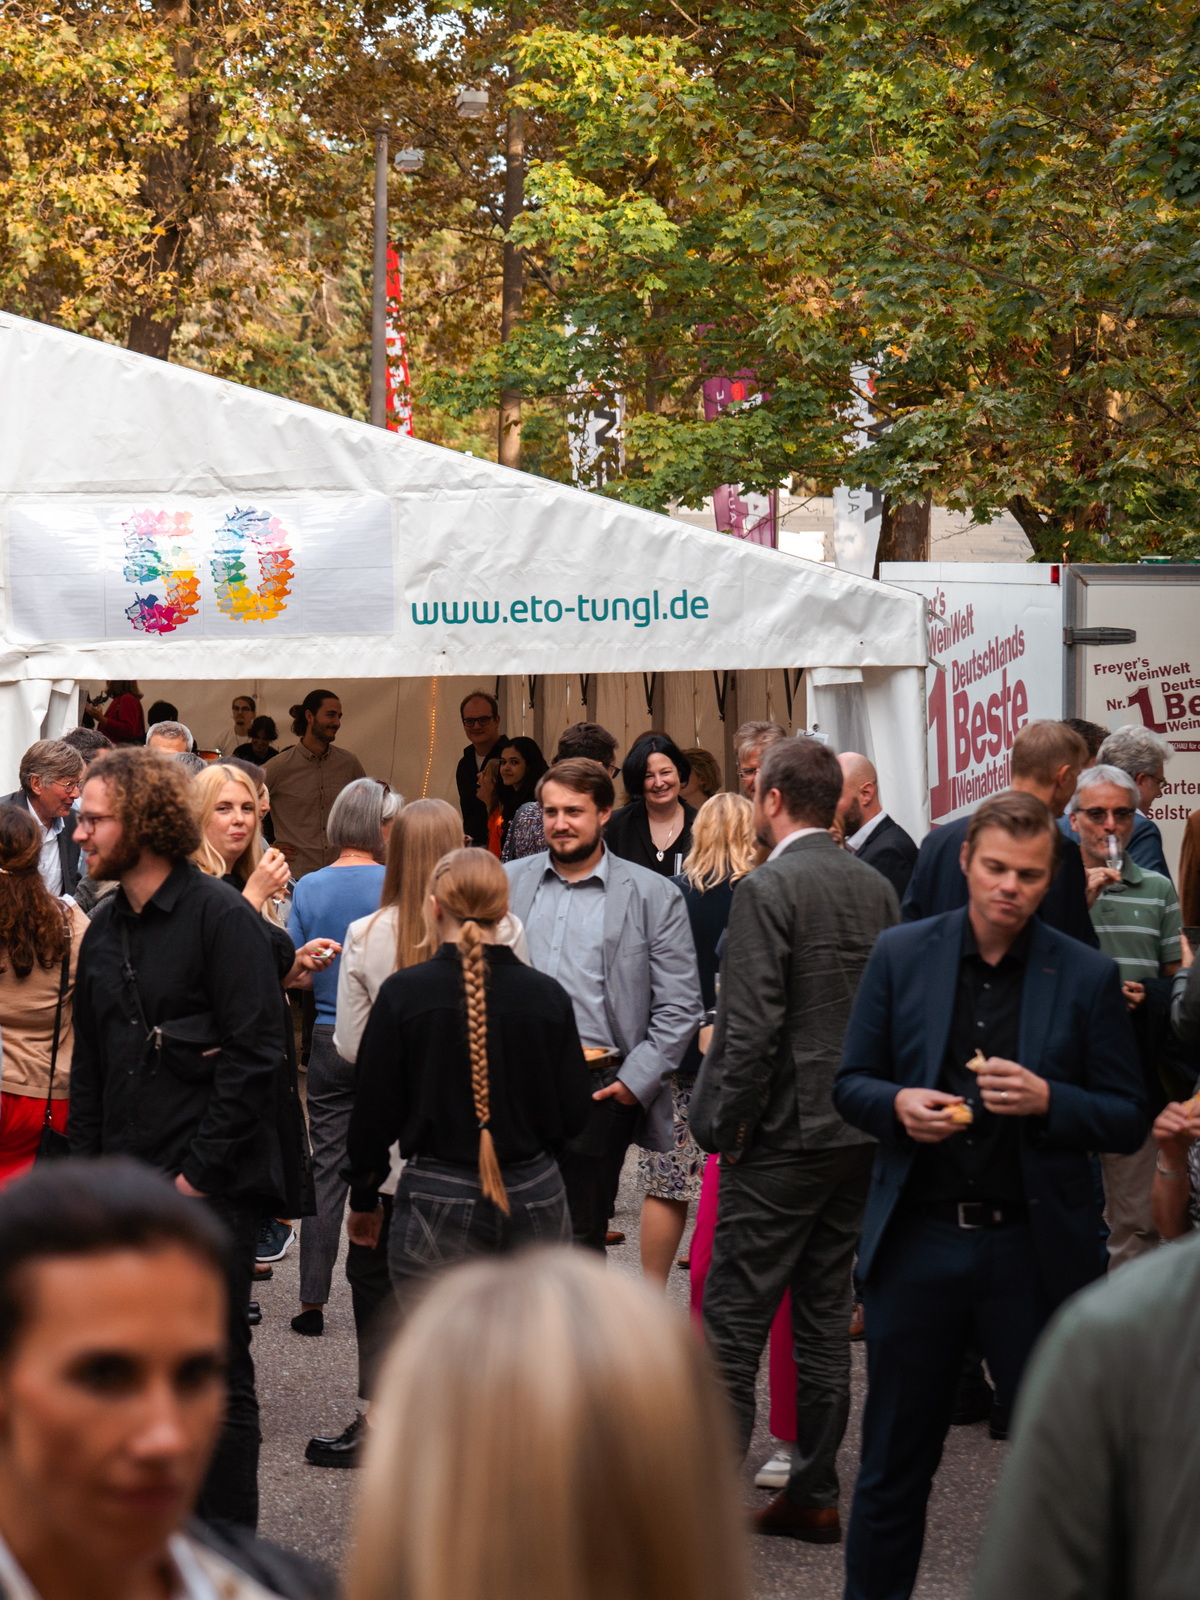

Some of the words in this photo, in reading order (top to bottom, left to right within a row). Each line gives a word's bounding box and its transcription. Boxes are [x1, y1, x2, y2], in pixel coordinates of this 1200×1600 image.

[412, 589, 709, 628] www.eto-tungl.de
[952, 624, 1025, 693] Deutschlands
[1094, 657, 1150, 676] Freyer's
[1125, 662, 1191, 683] WeinWelt
[953, 667, 1028, 774] Beste
[1106, 699, 1126, 711] Nr.
[1127, 685, 1168, 734] 1
[956, 752, 1011, 808] Weinabteil
